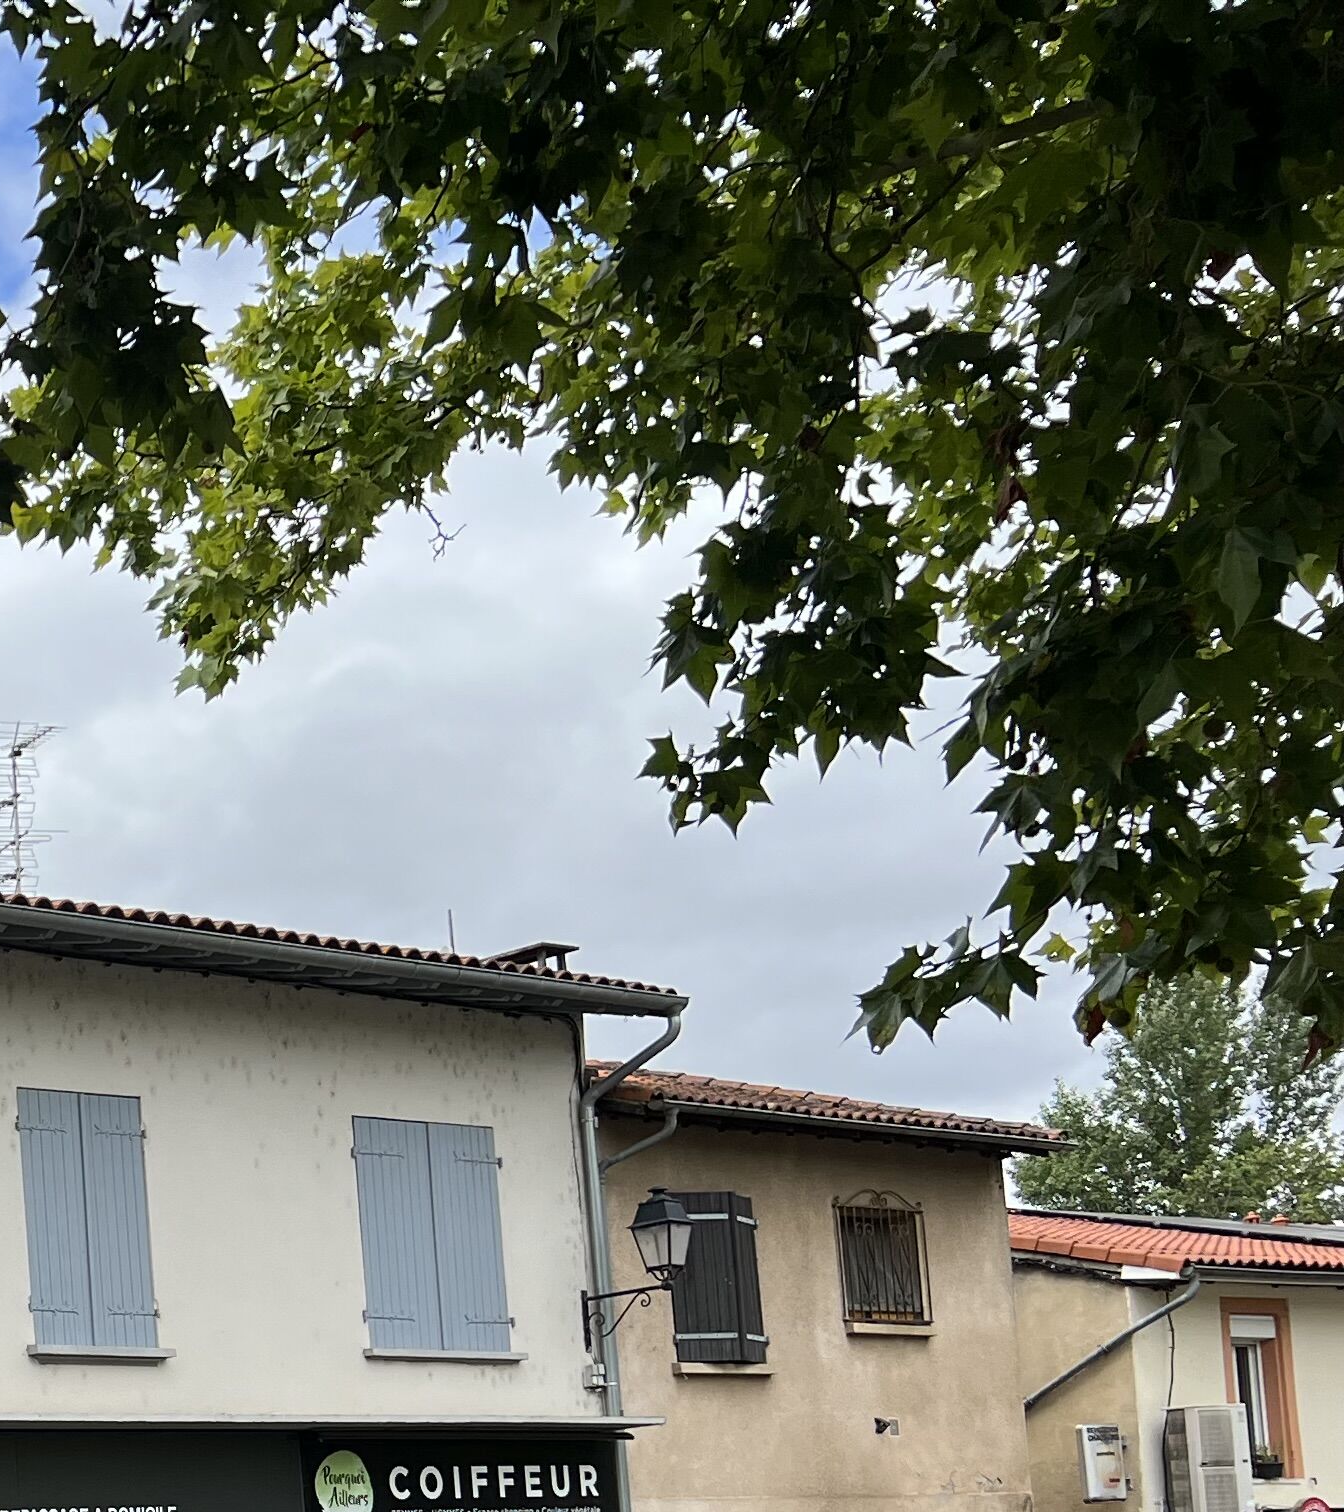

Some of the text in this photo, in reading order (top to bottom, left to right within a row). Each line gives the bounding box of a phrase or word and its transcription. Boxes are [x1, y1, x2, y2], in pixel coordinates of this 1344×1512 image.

[322, 1465, 367, 1490] Pourquoi
[388, 1465, 600, 1500] COIFFEUR
[328, 1486, 369, 1508] Ailleurs
